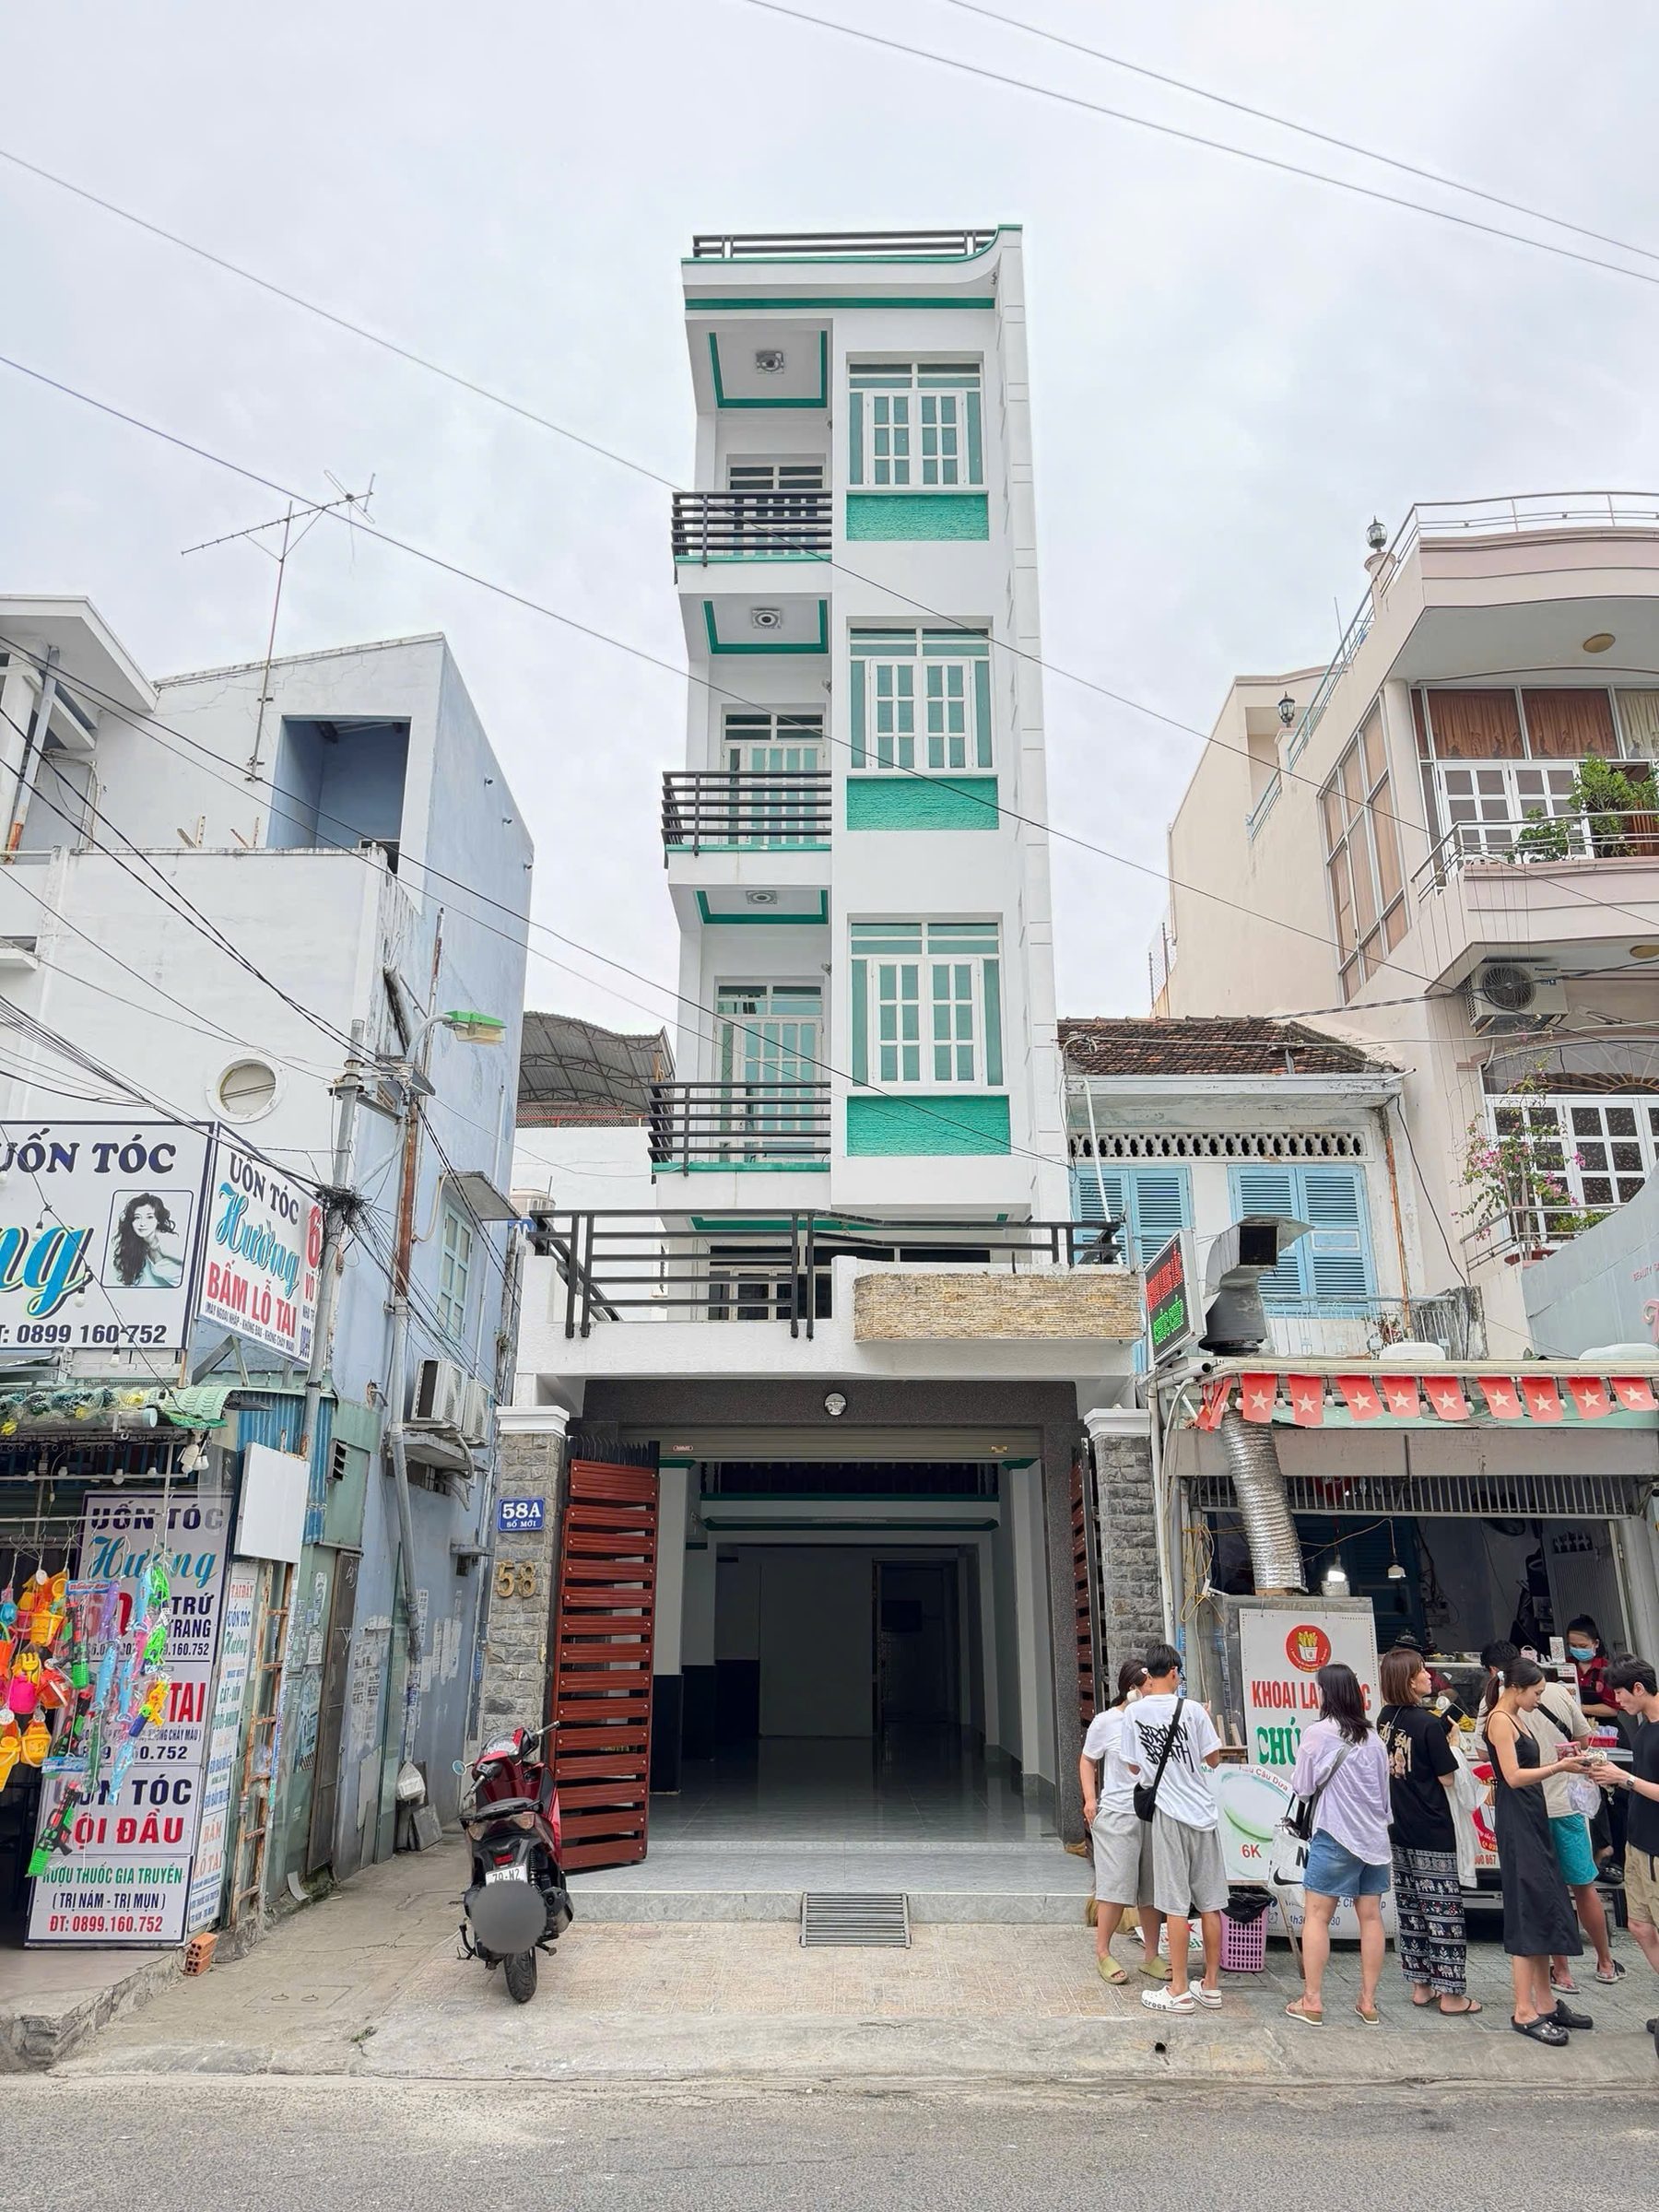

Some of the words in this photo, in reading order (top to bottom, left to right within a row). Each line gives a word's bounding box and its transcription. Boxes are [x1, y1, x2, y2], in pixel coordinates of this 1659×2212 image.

[91, 1134, 176, 1173] TÓC
[269, 1184, 300, 1225] TÓC
[206, 1259, 249, 1314] BẤM
[276, 1298, 297, 1338] TAI
[17, 1324, 71, 1343] 0899
[80, 1324, 120, 1343] 160
[126, 1324, 167, 1343] 752
[91, 1500, 156, 1530] UỐN
[168, 1504, 224, 1530] TÓC
[502, 1501, 541, 1519] 58A
[498, 1559, 536, 1597] 58
[170, 1682, 206, 1722] TAI
[1252, 1680, 1297, 1709] KHOAI
[1300, 1682, 1320, 1710] LA
[1135, 1720, 1189, 1746] BRON
[132, 1773, 192, 1806] TÓC
[74, 1812, 107, 1850] ỘI
[116, 1808, 183, 1843] ĐẦU
[1241, 1843, 1262, 1858] 6K
[76, 1861, 112, 1884] THUỐC
[115, 1867, 135, 1884] GIA
[78, 1889, 104, 1908] NÁM
[134, 1893, 159, 1912] MỤN
[50, 1915, 69, 1932] ĐT:
[72, 1915, 163, 1933] 0899.160.752
